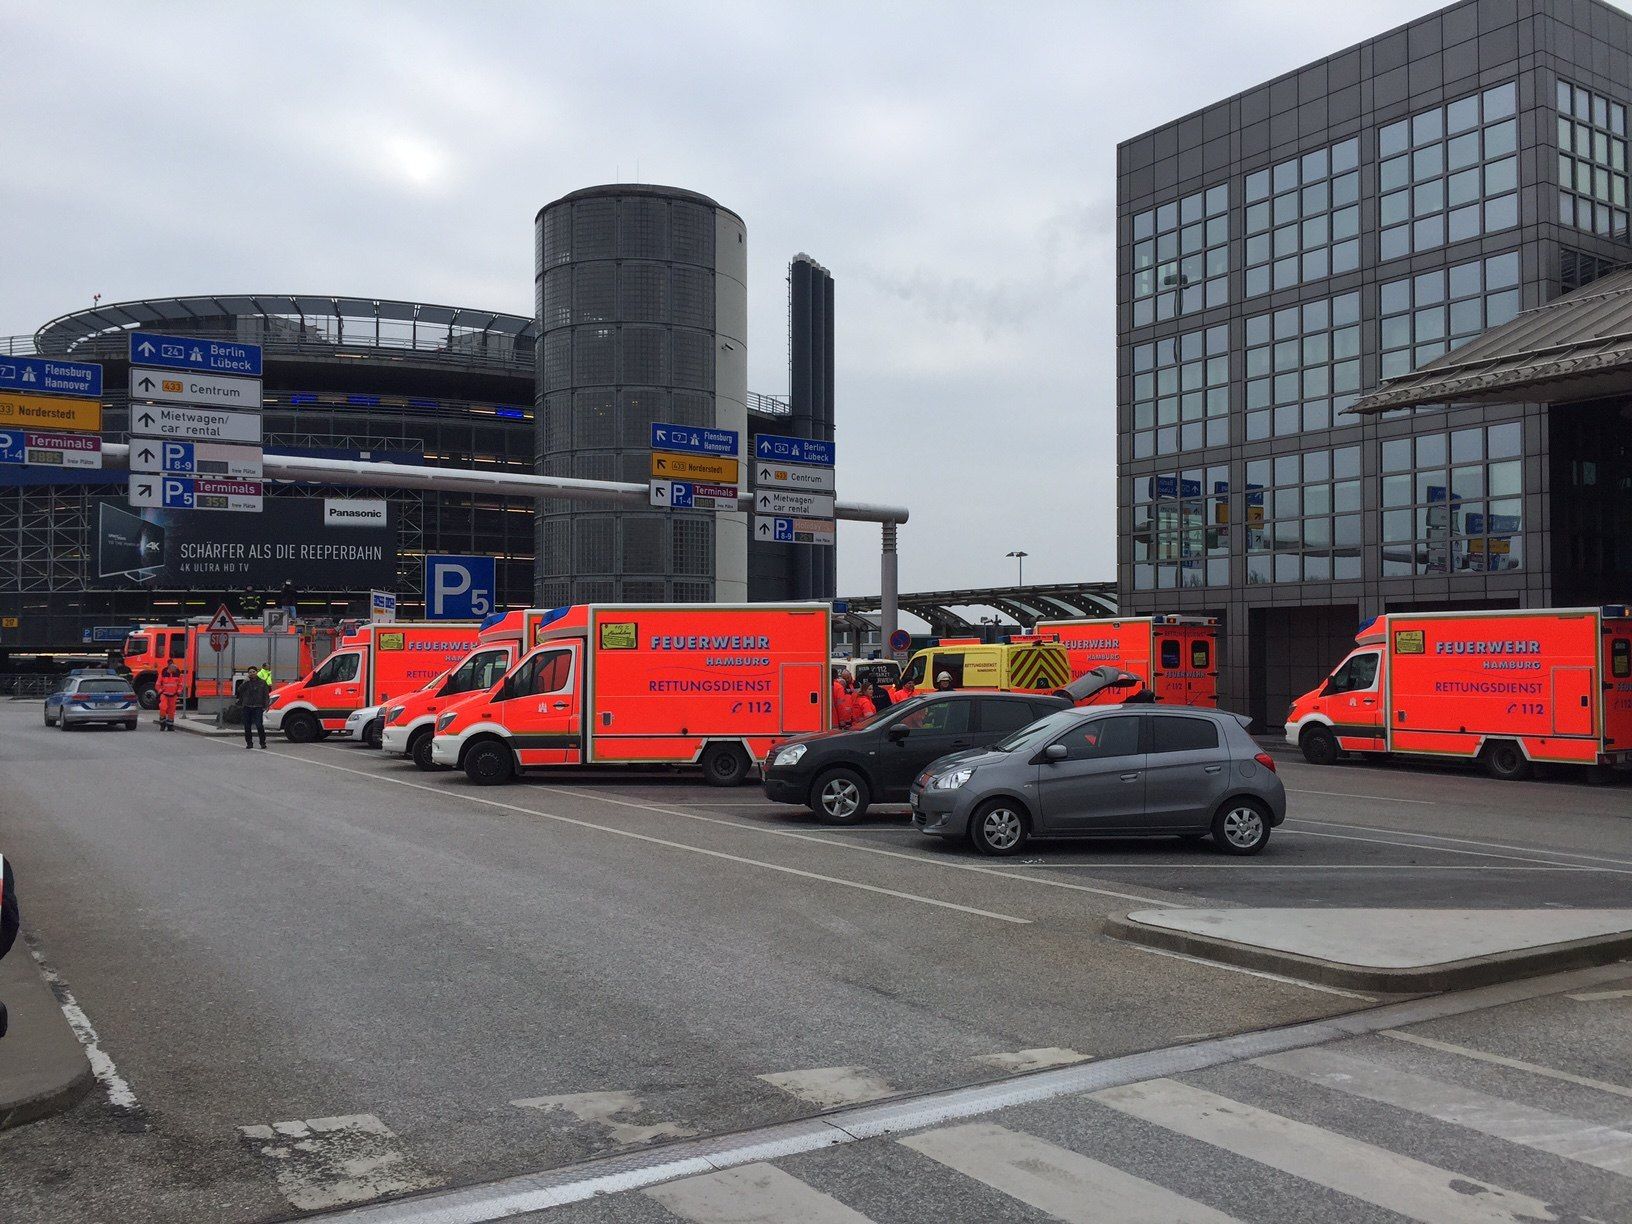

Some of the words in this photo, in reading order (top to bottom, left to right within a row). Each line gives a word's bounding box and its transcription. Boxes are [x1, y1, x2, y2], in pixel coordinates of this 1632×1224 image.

[167, 347, 179, 356] 24
[210, 344, 245, 358] Berlin
[210, 357, 252, 371] Lübeck
[45, 364, 92, 381] Flensburg
[45, 377, 89, 390] Hannover
[164, 382, 181, 391] 433
[190, 383, 240, 398] Centrum
[19, 405, 76, 420] Norderstedt
[161, 410, 230, 426] Mietwagen/
[161, 424, 179, 434] car
[186, 426, 221, 437] rental
[30, 435, 93, 449] Terminals
[704, 431, 733, 444] Flensburg
[704, 441, 731, 452] Hannover
[804, 442, 826, 452] Berlin
[165, 443, 185, 469] P
[804, 452, 829, 462] Lübeck
[174, 461, 192, 470] 8-9
[688, 463, 723, 474] Norderstedt
[791, 473, 822, 483] Centrum
[165, 480, 183, 504] P
[183, 493, 192, 504] 5
[198, 481, 255, 495] Terminals
[673, 484, 685, 504] P
[679, 496, 691, 505] 1-4
[695, 486, 734, 497] Terminals
[773, 493, 815, 506] Mietwagen/
[329, 508, 382, 518] Panasonic
[788, 504, 810, 514] rental
[775, 520, 788, 539] P
[180, 541, 245, 559] SCHÄRFER
[248, 544, 272, 559] ALS
[276, 544, 296, 560] DIE
[300, 545, 382, 560] REEPERBAHN
[180, 562, 191, 572] 4K
[194, 562, 220, 572] ULTRA
[223, 562, 235, 572] HD
[238, 563, 250, 572] TV
[434, 563, 472, 615] P
[471, 589, 490, 615] 5
[408, 640, 480, 650] FEUERWEH
[650, 635, 770, 651] FEUERWEHR
[1064, 639, 1120, 650] EUERWEHR
[1435, 640, 1541, 655] FEUERWEHR
[706, 657, 770, 667] HAMBURG
[1087, 653, 1120, 661] HAMBURG
[1482, 660, 1541, 670] HAMBURG
[649, 680, 772, 692] RETTUNGSDIENST
[1434, 681, 1543, 694] RETTUNGSDIENST
[748, 701, 773, 713] 112
[1521, 703, 1544, 715] 112
